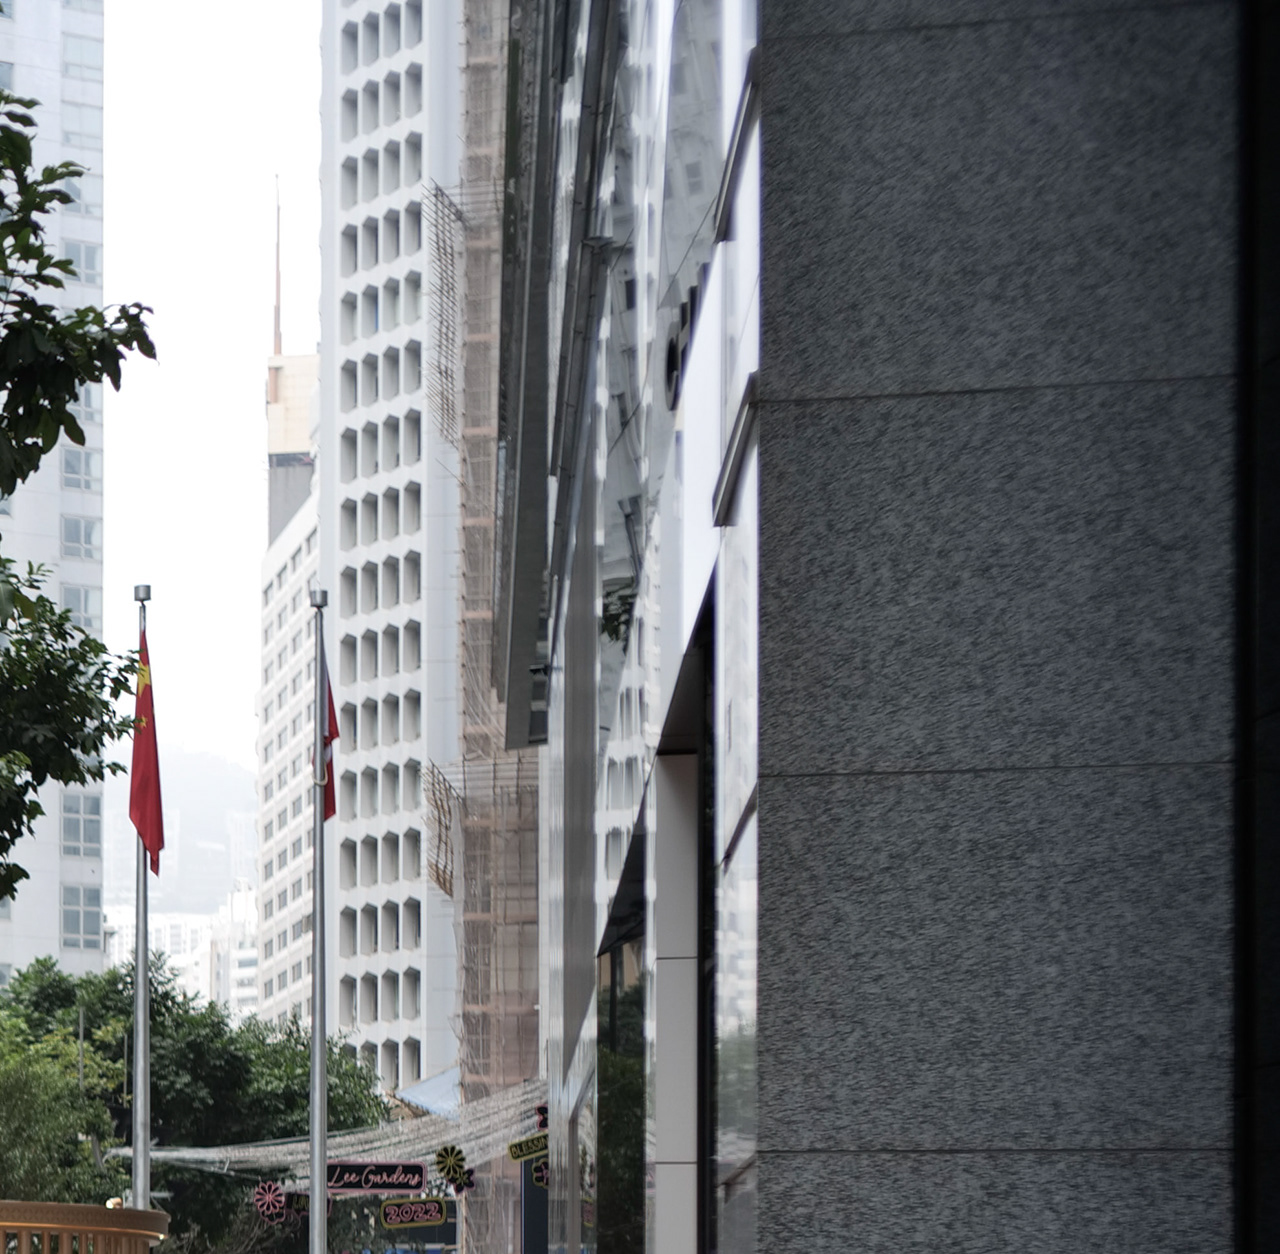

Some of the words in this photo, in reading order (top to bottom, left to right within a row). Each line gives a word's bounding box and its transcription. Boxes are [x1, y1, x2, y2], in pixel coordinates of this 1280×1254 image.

[328, 1166, 359, 1187] Lee
[361, 1165, 421, 1188] Gardens
[385, 1202, 441, 1224] 2022
